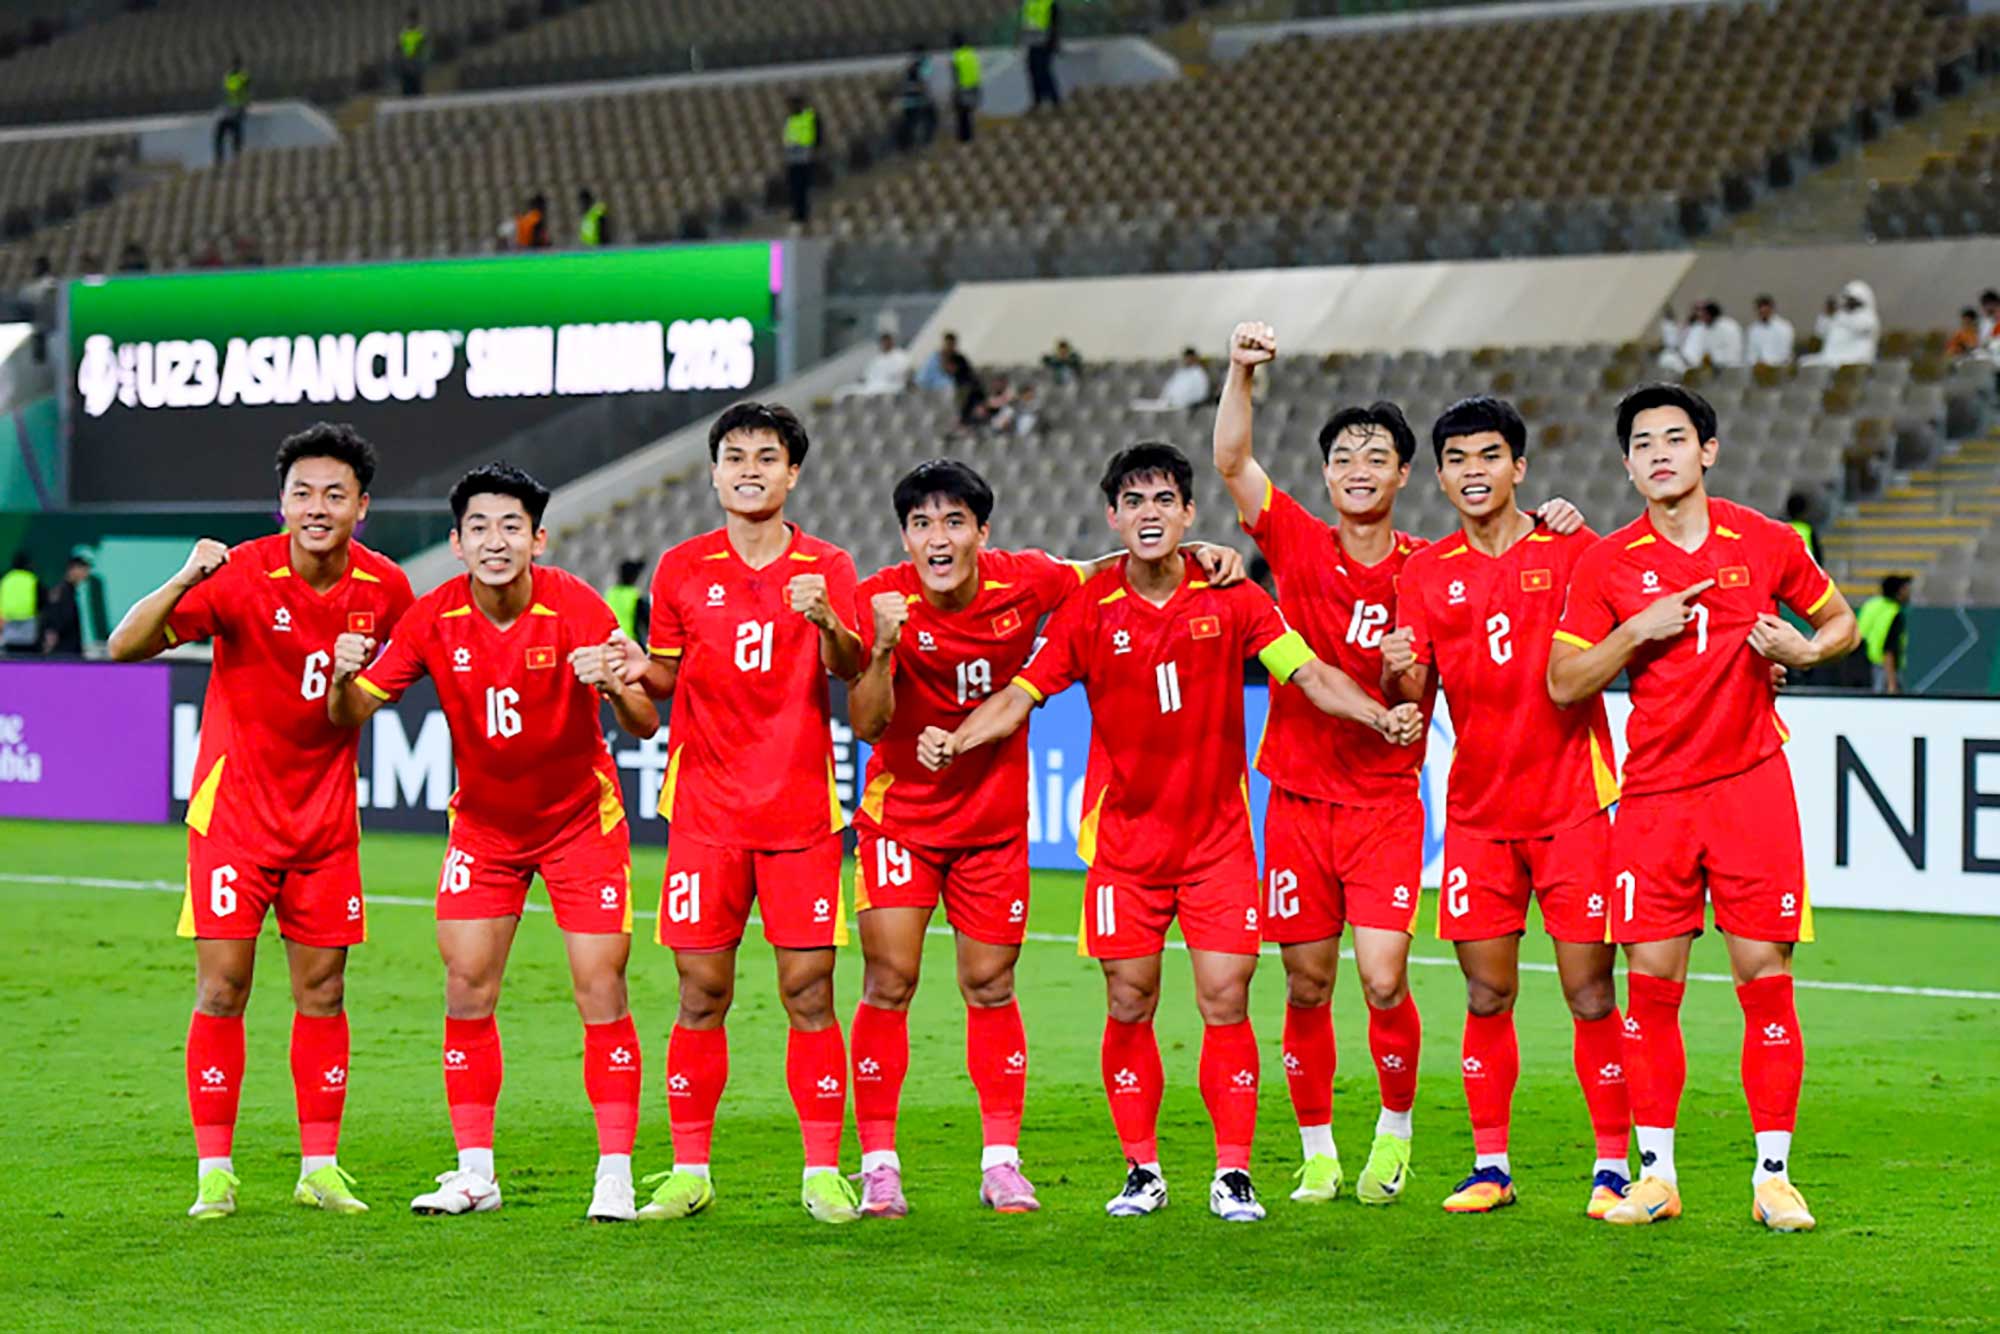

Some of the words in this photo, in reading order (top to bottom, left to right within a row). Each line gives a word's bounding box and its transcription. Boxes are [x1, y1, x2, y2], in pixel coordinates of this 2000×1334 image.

[136, 338, 218, 409] U23
[218, 333, 356, 405] ASIAN
[355, 329, 455, 401] CUP
[734, 619, 775, 673] 21
[1345, 599, 1389, 649] 12
[1486, 612, 1512, 665] 2
[1686, 602, 1709, 654] 7
[301, 649, 331, 701] 6
[956, 658, 992, 705] 19
[1155, 660, 1183, 714] 11
[485, 686, 523, 739] 16
[440, 846, 475, 894] 16
[876, 837, 912, 888] 19
[211, 864, 239, 918] 6
[668, 870, 700, 924] 21
[1096, 885, 1117, 936] 11
[1268, 867, 1300, 919] 12
[1448, 866, 1469, 919] 2
[1616, 870, 1636, 922] 7
